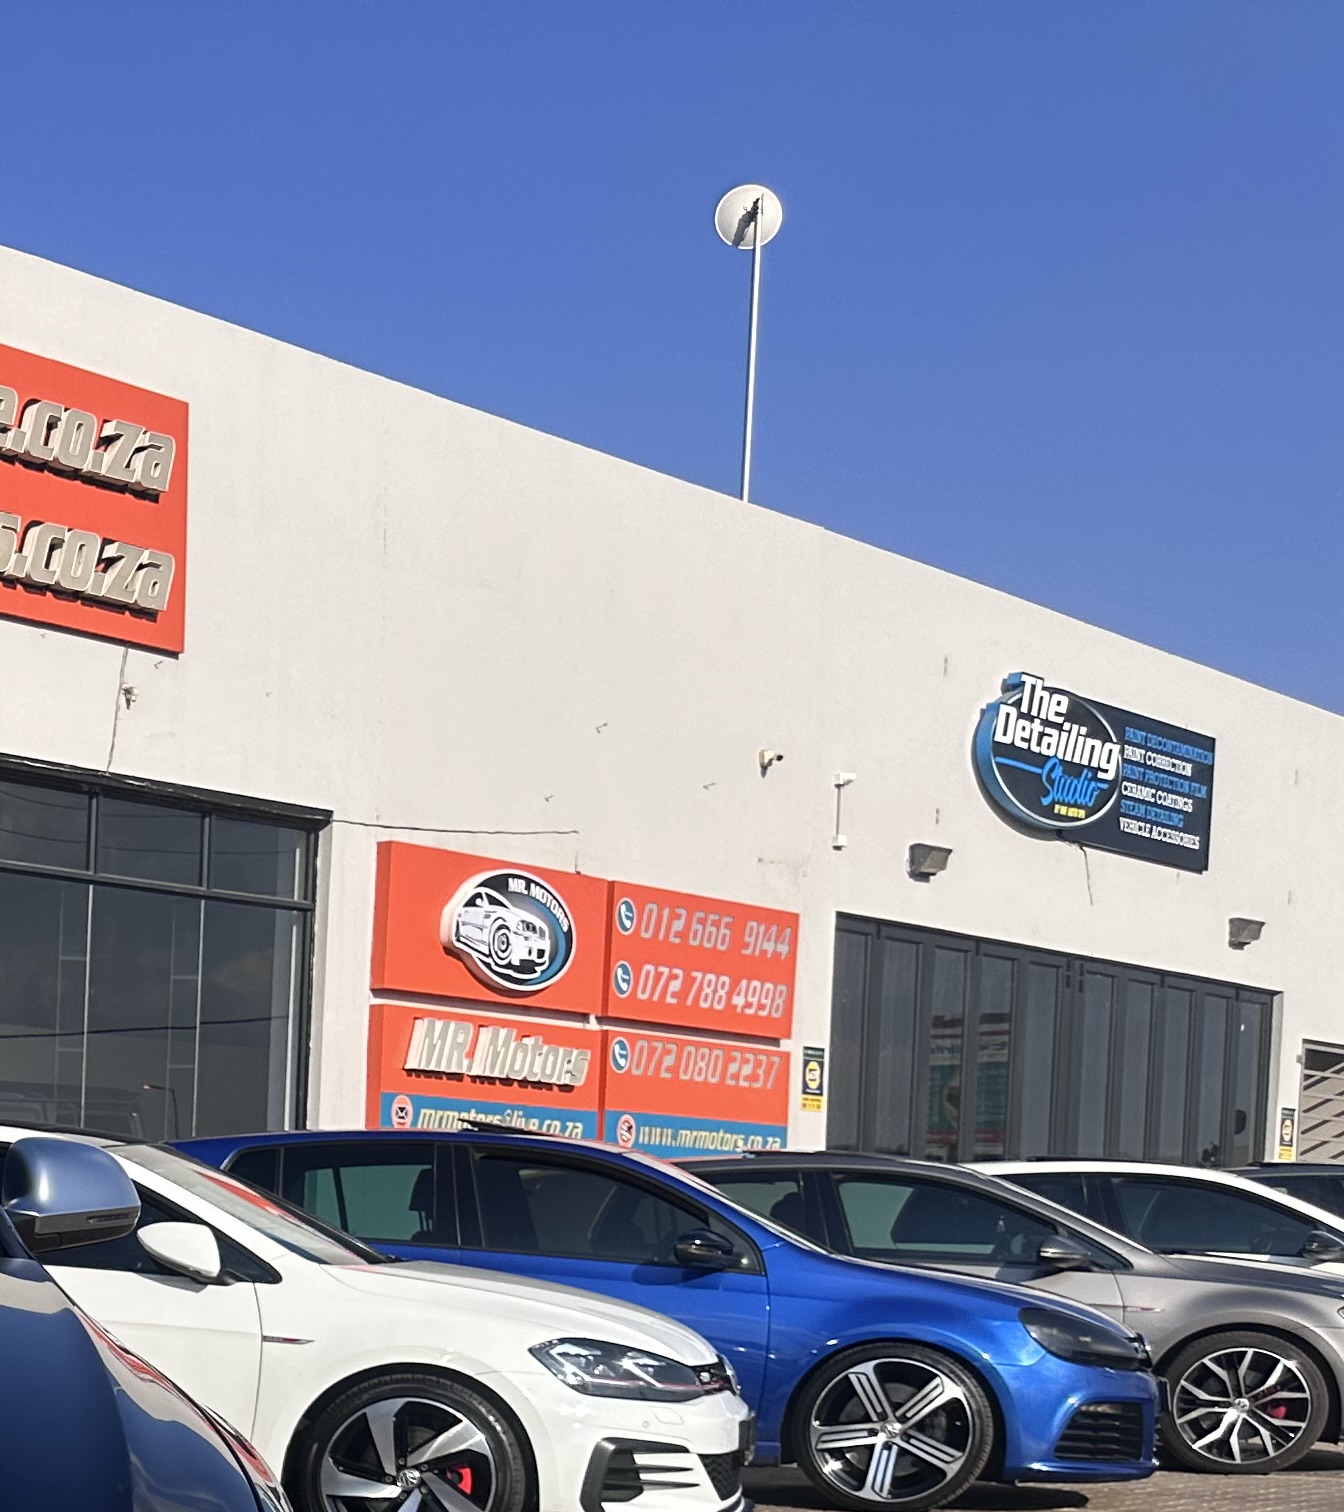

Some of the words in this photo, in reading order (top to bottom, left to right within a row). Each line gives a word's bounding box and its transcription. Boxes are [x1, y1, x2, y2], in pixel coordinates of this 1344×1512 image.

[1020, 674, 1069, 724] The
[994, 704, 1120, 781] Detailing
[1040, 757, 1102, 807] Studio
[508, 878, 528, 895] MR.
[530, 883, 569, 932] MOTORS
[640, 902, 688, 943] 012
[689, 911, 734, 951] 666
[741, 920, 793, 960] 9144
[636, 963, 684, 1004] 072
[686, 971, 731, 1010] 788
[732, 979, 788, 1018] 4998
[408, 1017, 474, 1074] MR.
[476, 1025, 591, 1087] Motors
[631, 1039, 678, 1078] 072
[679, 1045, 724, 1083] 080
[725, 1051, 782, 1090] 2237
